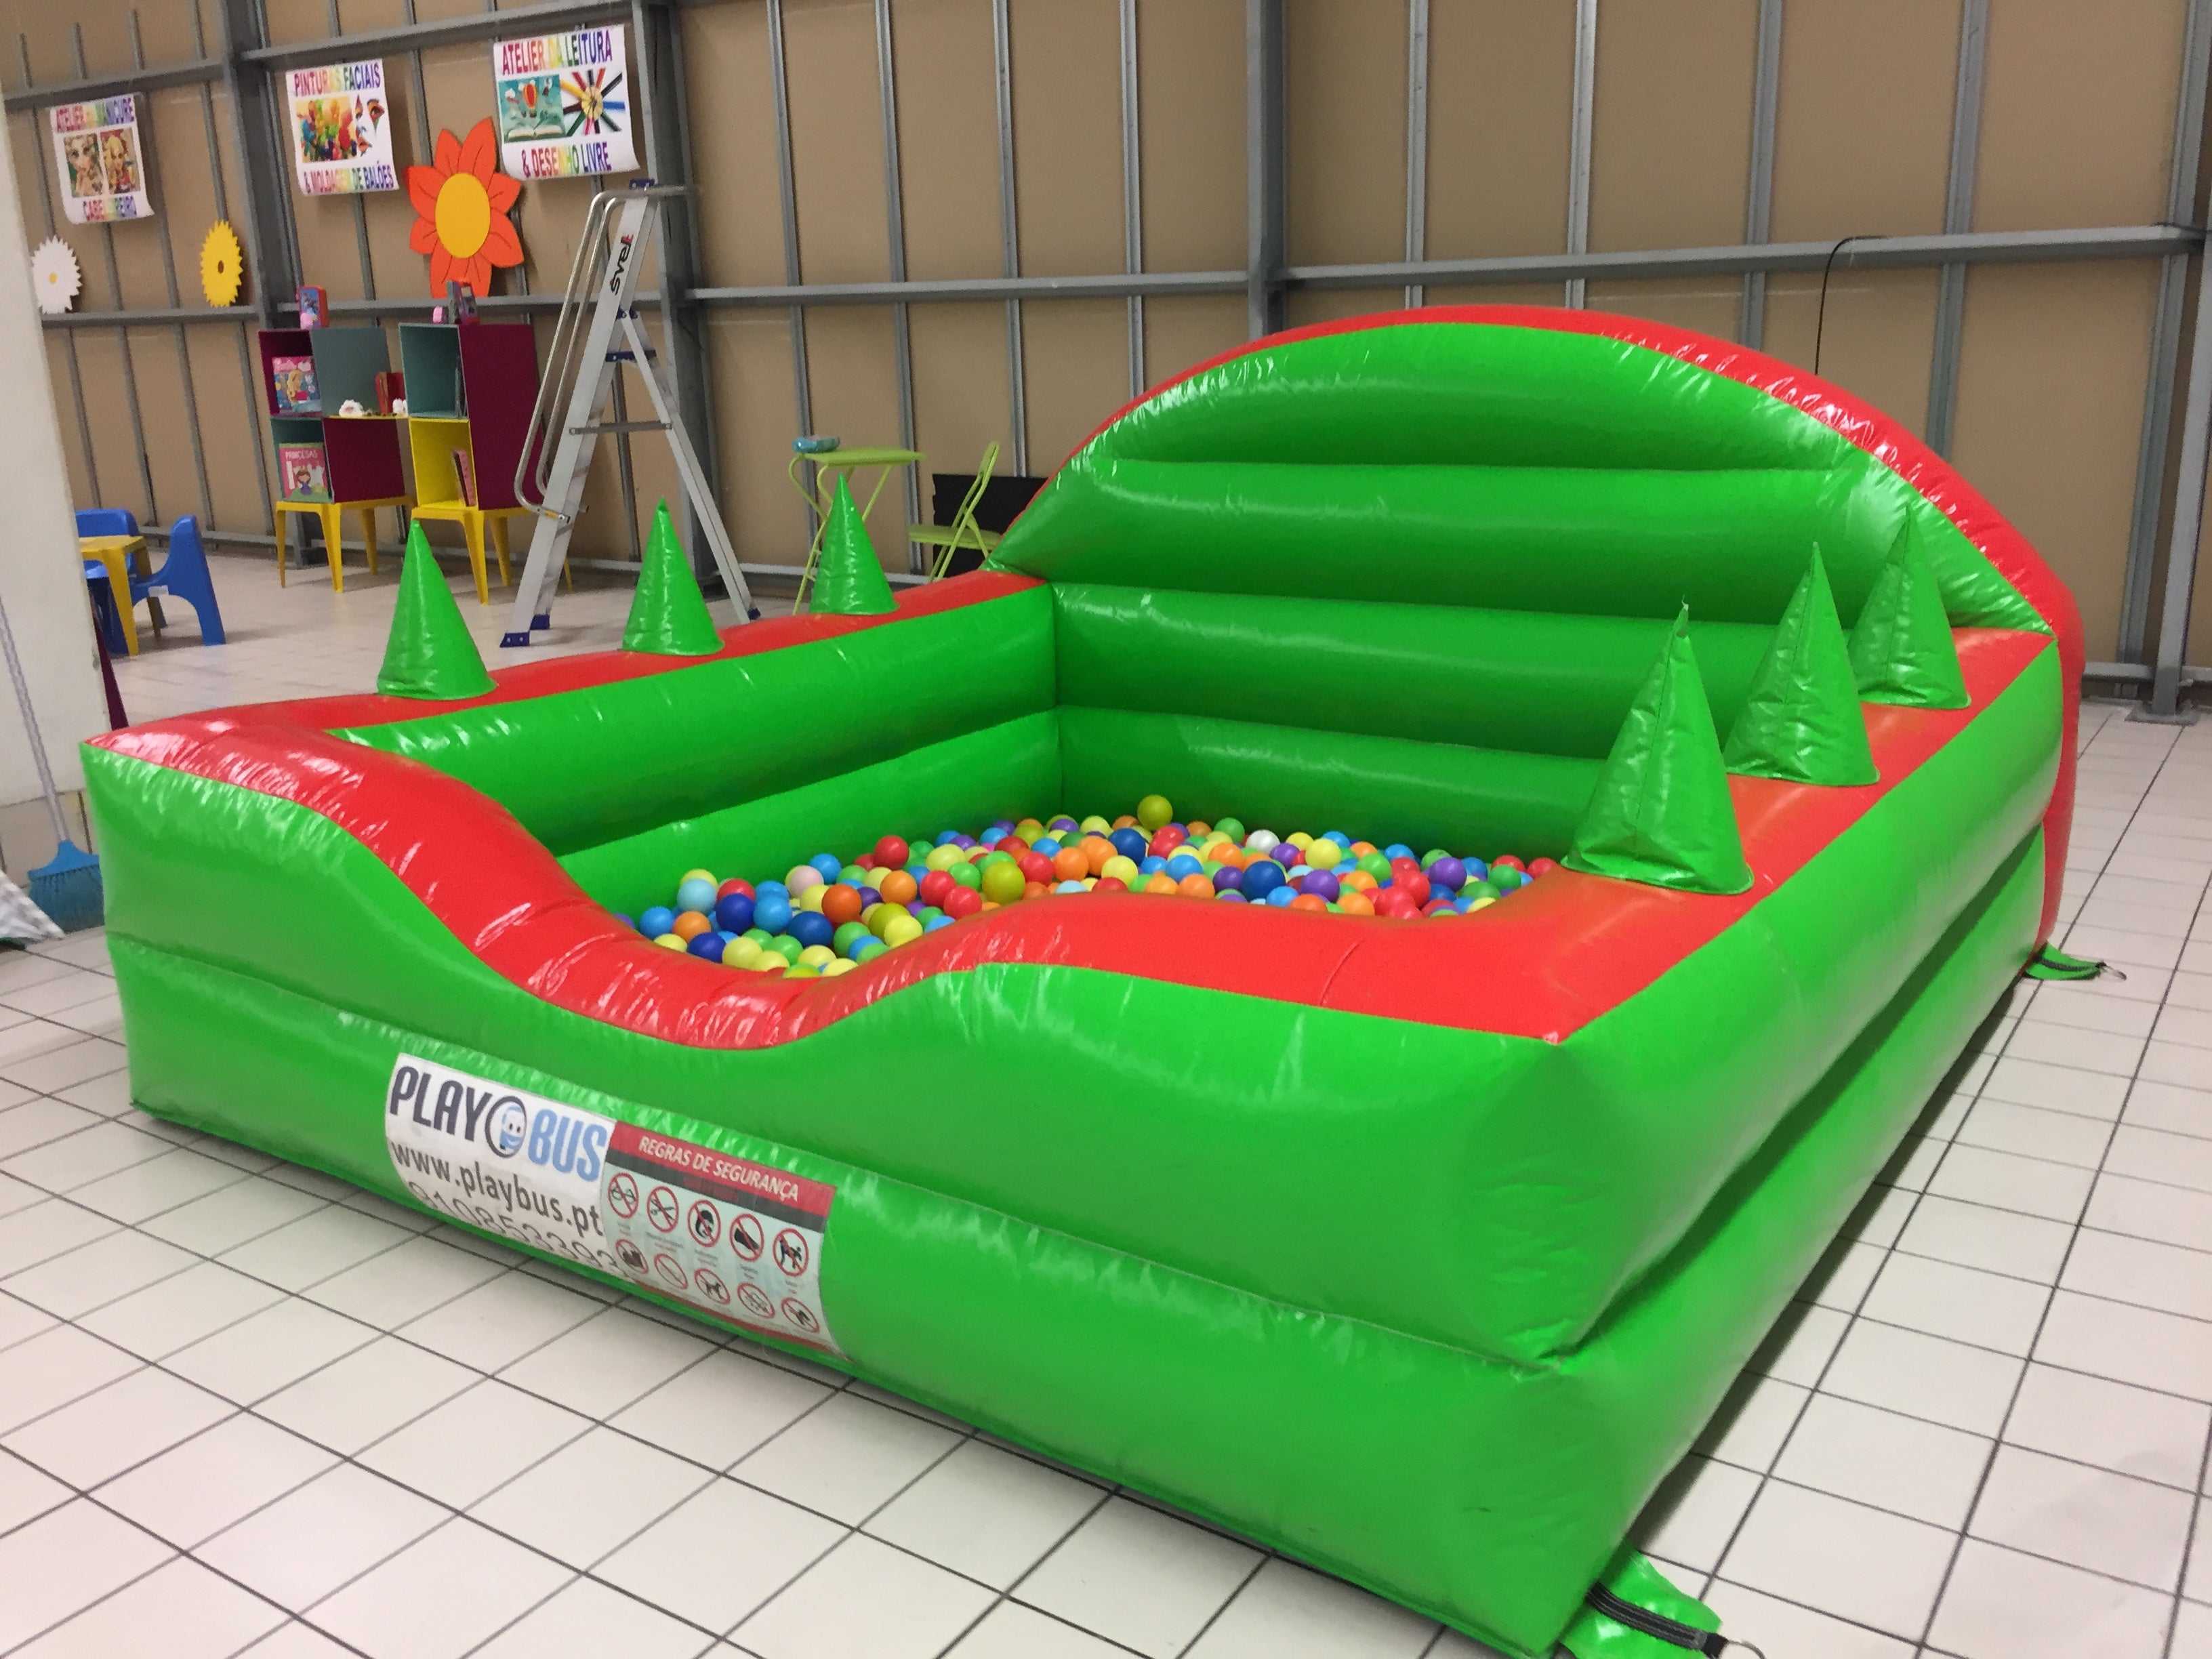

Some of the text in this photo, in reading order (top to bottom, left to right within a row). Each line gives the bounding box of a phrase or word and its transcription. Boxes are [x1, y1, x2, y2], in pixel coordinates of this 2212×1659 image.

[503, 39, 546, 76] ATELIER
[565, 29, 613, 67] LEITURA
[293, 62, 381, 97] PINTURAS FACIAIS
[352, 167, 364, 190] DE
[363, 160, 394, 190] BALÕES
[521, 149, 531, 178] &
[580, 141, 613, 173] LIVRE
[390, 1066, 608, 1182] PLAY BUS
[391, 1142, 604, 1237] www.playbus.pt
[638, 1136, 798, 1202] REGRAS DE SEGURANÇA
